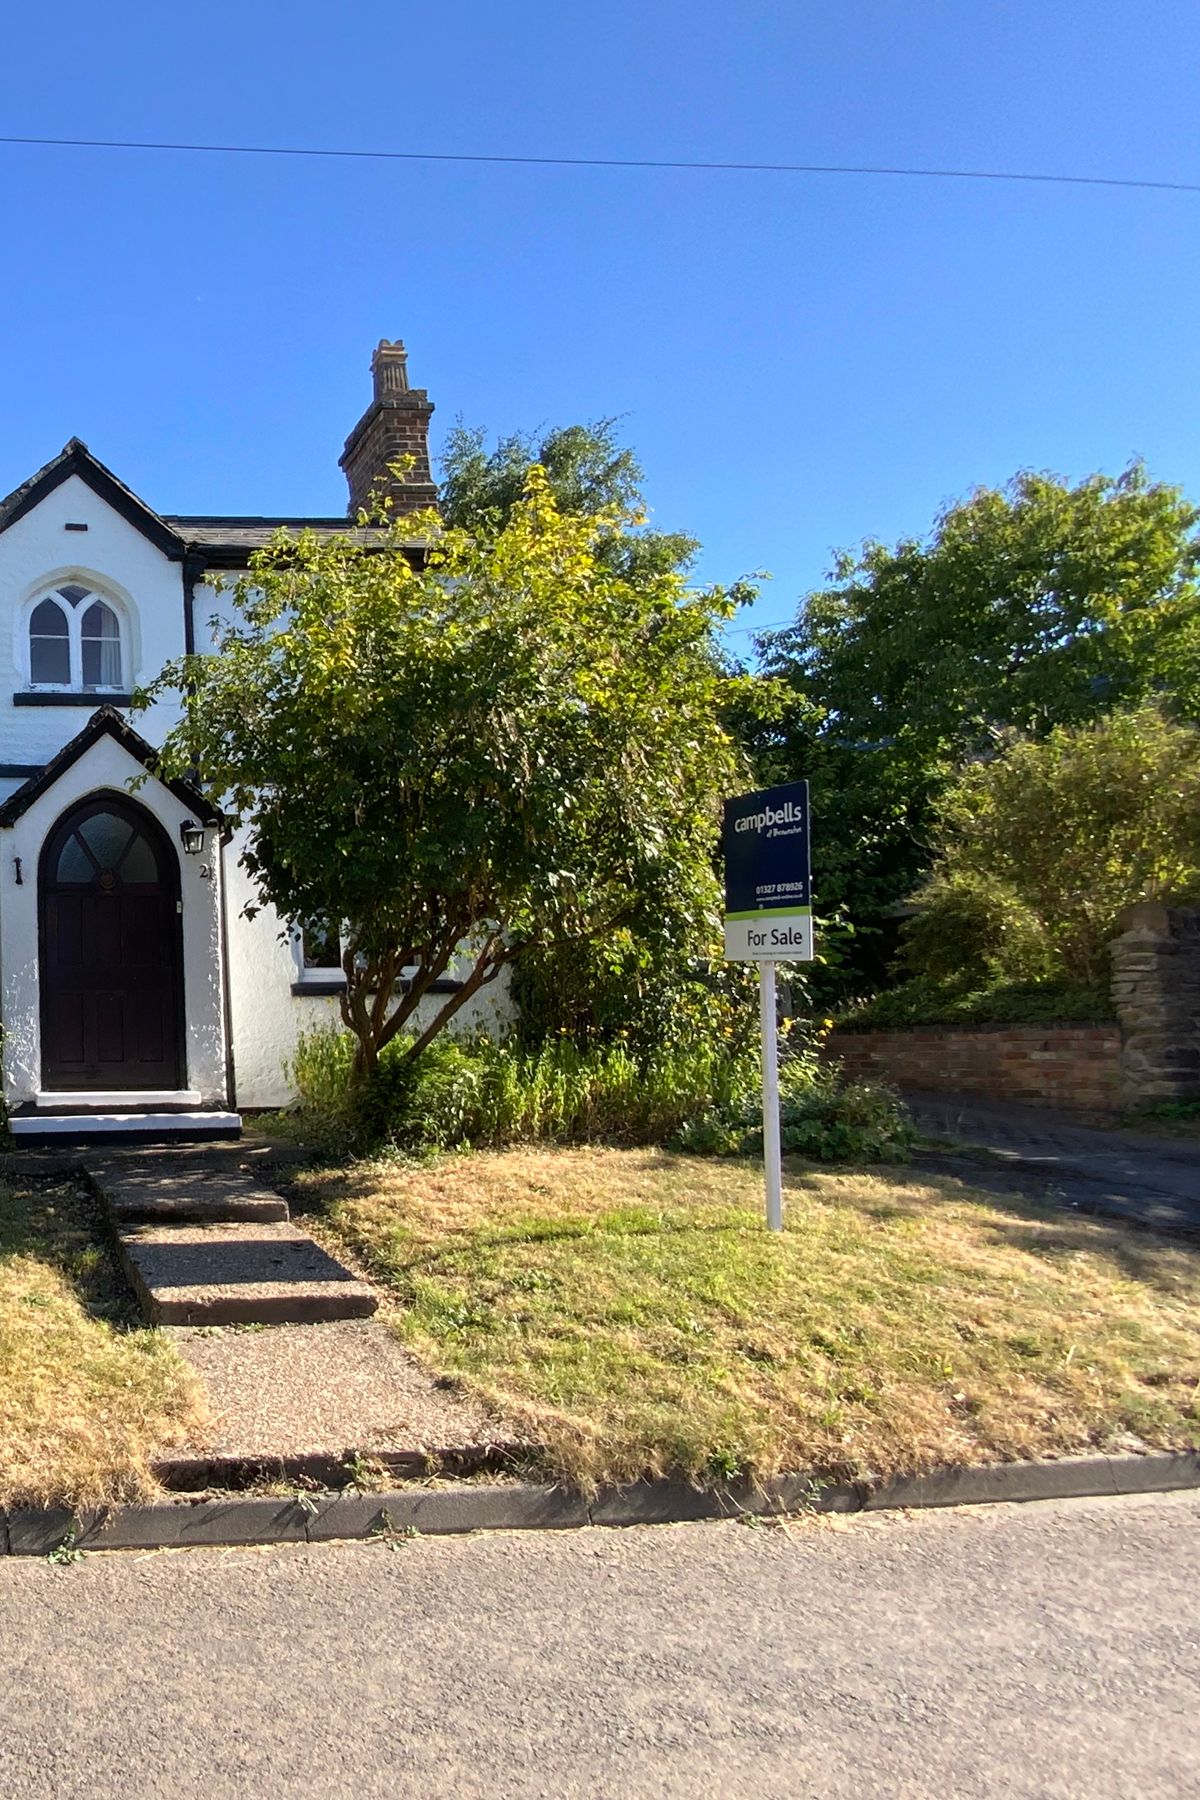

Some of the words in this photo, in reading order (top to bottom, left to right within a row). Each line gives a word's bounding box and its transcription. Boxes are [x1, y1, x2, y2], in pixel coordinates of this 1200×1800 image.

[734, 802, 802, 833] campbells
[756, 884, 776, 895] 01327
[747, 930, 767, 947] For
[771, 927, 803, 945] Sale
